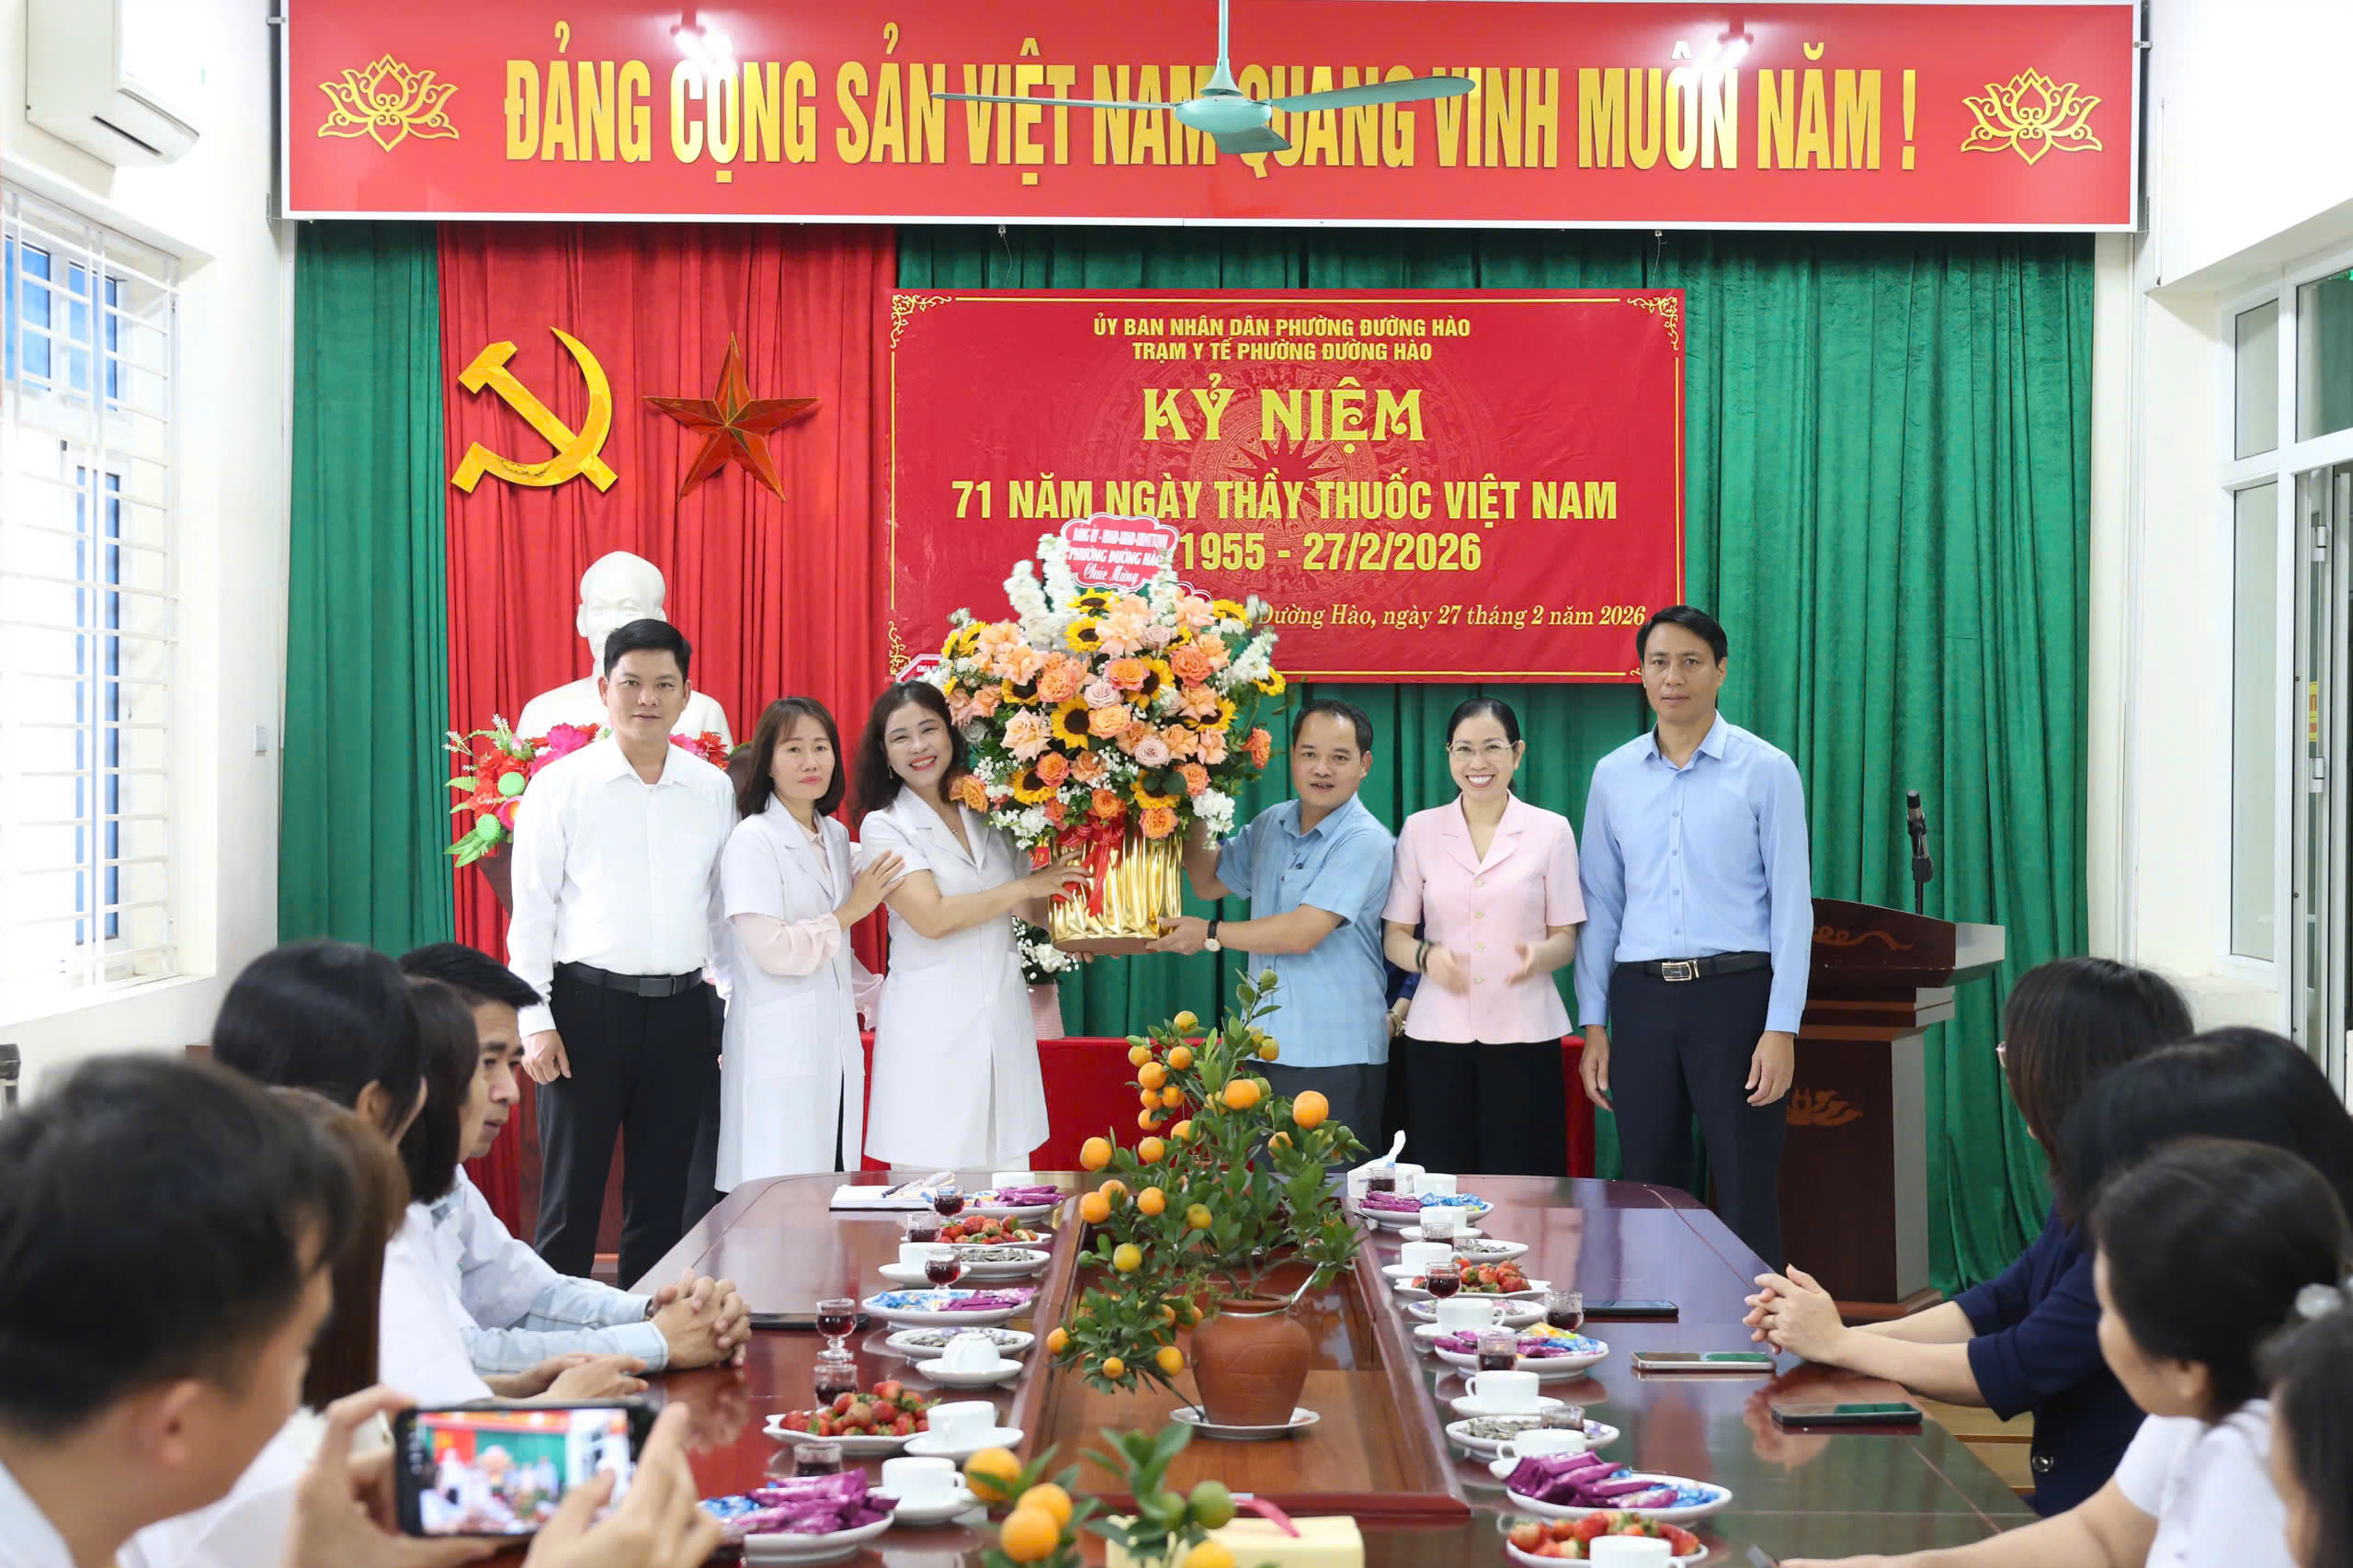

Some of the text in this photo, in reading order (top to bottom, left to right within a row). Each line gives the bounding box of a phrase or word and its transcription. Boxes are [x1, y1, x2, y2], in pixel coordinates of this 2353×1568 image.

[504, 19, 654, 164] ĐẢNG
[835, 22, 948, 165] SẢN
[962, 37, 1075, 186] VIỆT
[1093, 64, 1216, 165] NAM
[1432, 66, 1557, 168] VINH
[1579, 40, 1739, 170] MUÔN
[1756, 40, 1881, 170] NĂM
[1903, 68, 1917, 171] !
[1094, 312, 1471, 337] ỦY BAN NHÂN DÂN PHƯỜNG ĐƯỜNG HÀO
[1131, 336, 1432, 364] TRẠM Y TẾ PHƯỜNG ĐƯỜNG HÀO
[1142, 372, 1426, 457] KỶ NIỆM
[951, 466, 1617, 528] 71 NĂM NGÀY THẦY THUỐC VIỆT NAM
[1068, 546, 1108, 562] PHƯỜNG
[1108, 548, 1142, 565] ĐƯỜNG
[1277, 549, 1291, 559] -
[1302, 531, 1482, 571] 27/2/2026
[1330, 604, 1376, 629] Hào,
[1382, 605, 1433, 630] ngày
[1438, 605, 1462, 625] 27
[1467, 604, 1528, 630] tháng
[1530, 605, 1544, 625] 2
[1548, 605, 1594, 626] năm
[1598, 605, 1646, 626] 2026
